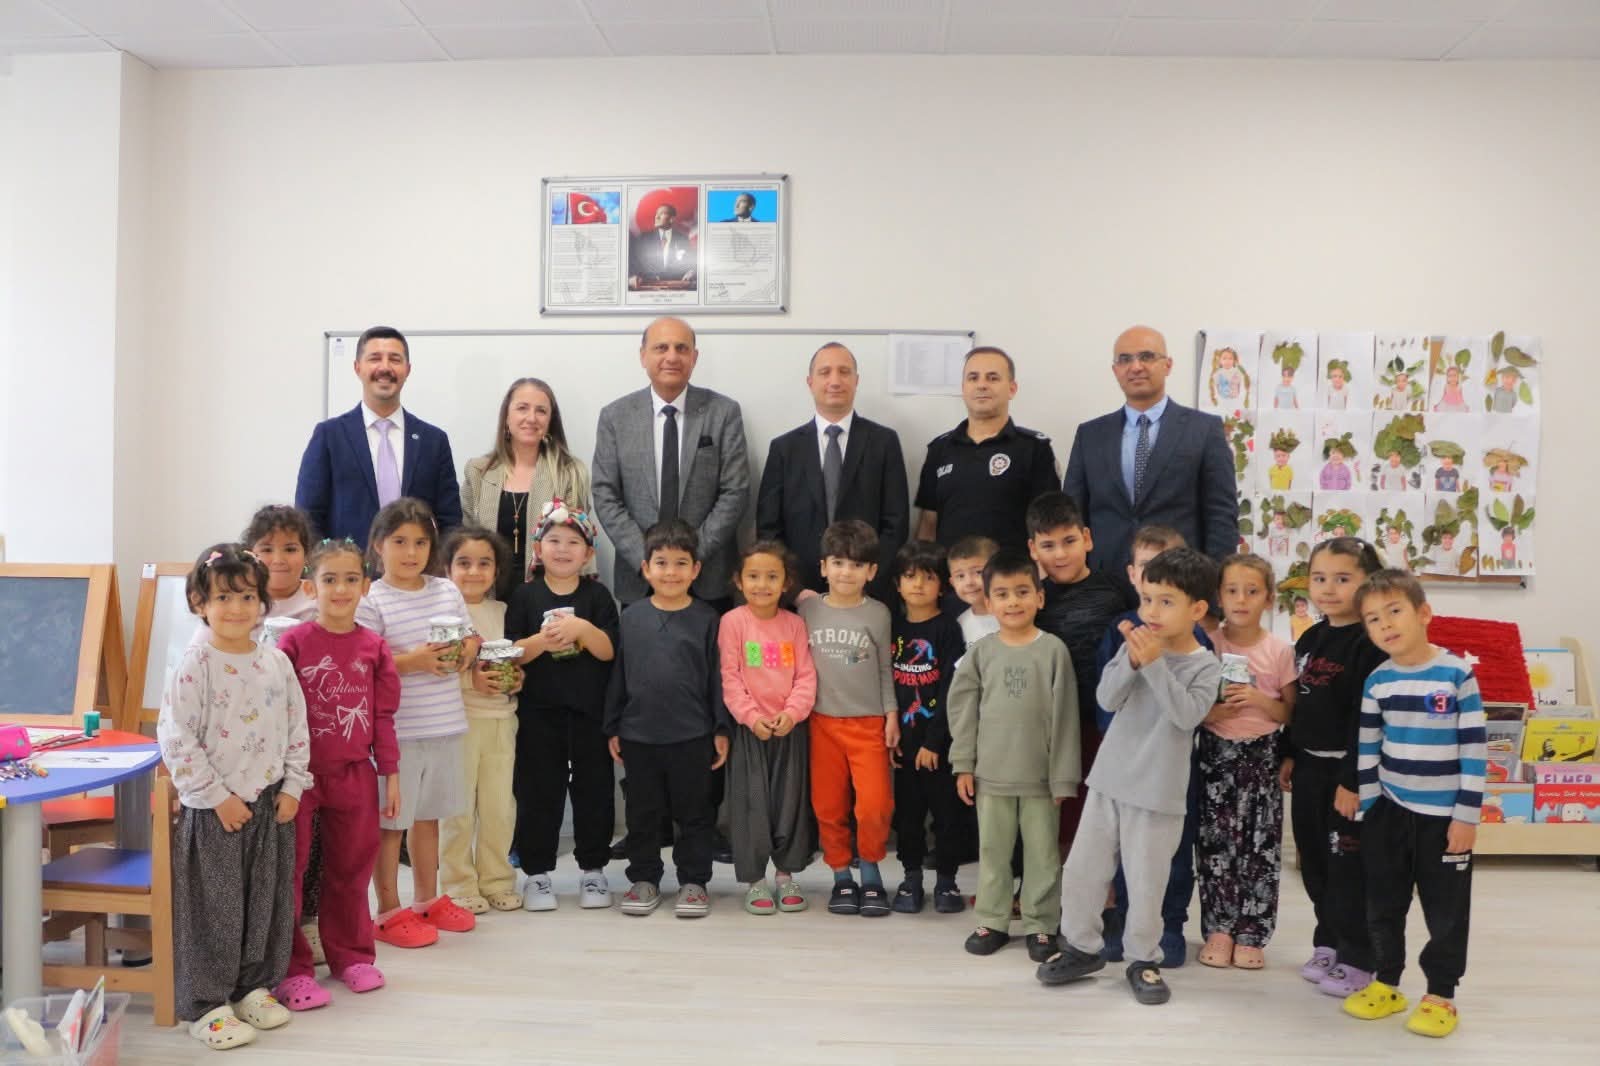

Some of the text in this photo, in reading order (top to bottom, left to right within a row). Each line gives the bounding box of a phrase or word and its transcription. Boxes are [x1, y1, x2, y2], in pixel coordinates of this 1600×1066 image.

[1004, 679, 1028, 689] WITH
[1008, 689, 1024, 698] ME
[1434, 695, 1447, 712] 3
